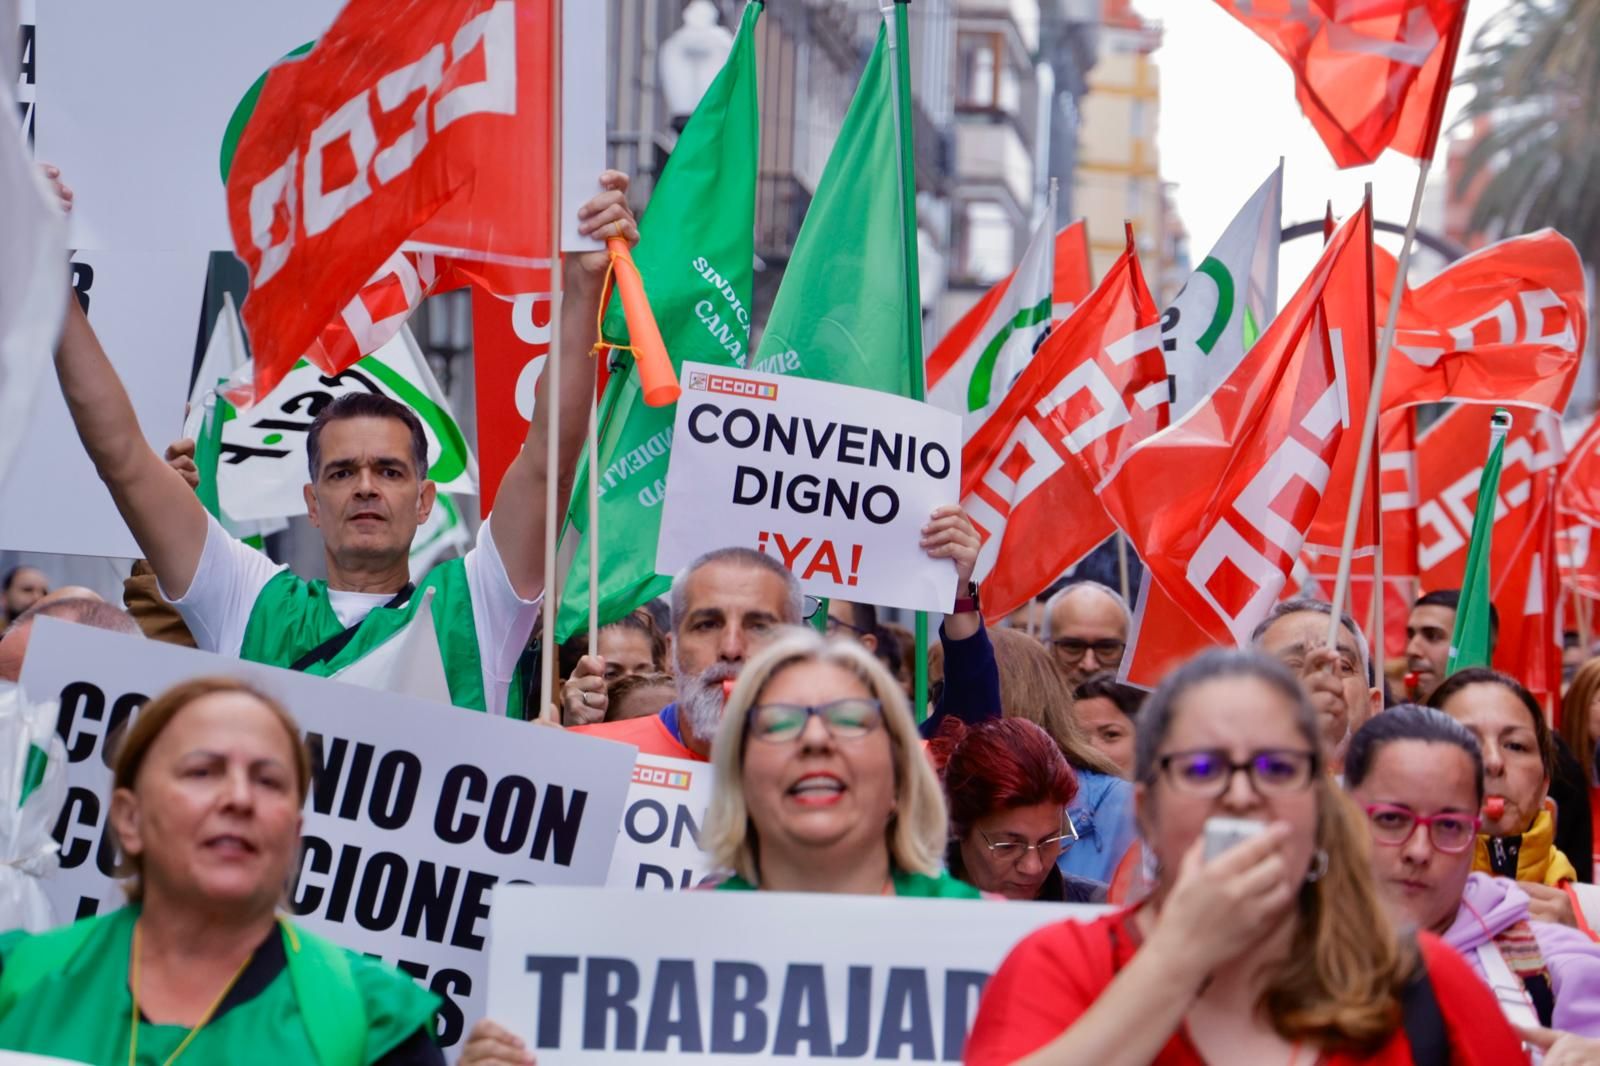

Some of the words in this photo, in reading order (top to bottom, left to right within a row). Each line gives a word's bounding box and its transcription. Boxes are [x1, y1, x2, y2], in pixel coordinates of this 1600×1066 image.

[711, 378, 757, 395] CCOO
[687, 403, 951, 480] CONVENIO
[732, 465, 900, 525] DIGNO
[758, 531, 863, 587] ¡YA!
[434, 764, 588, 867] CON
